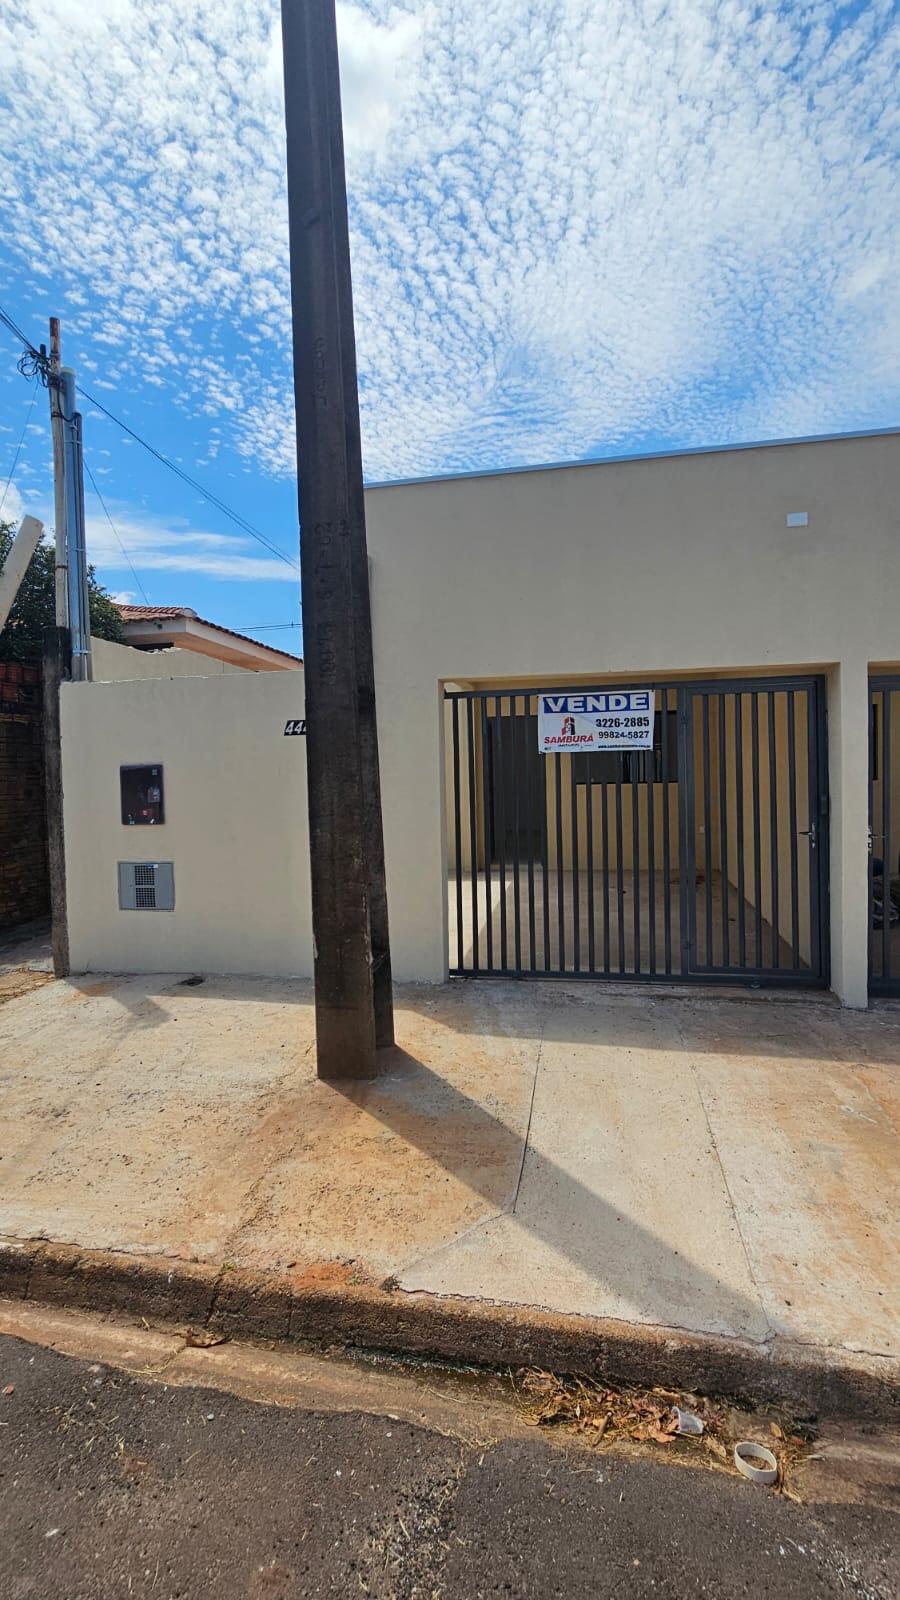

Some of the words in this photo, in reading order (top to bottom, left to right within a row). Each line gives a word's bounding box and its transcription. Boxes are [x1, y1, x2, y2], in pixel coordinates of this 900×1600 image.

[546, 693, 647, 712] VENDE
[595, 717, 650, 728] 3226-2885
[598, 730, 650, 739] 99824-5827
